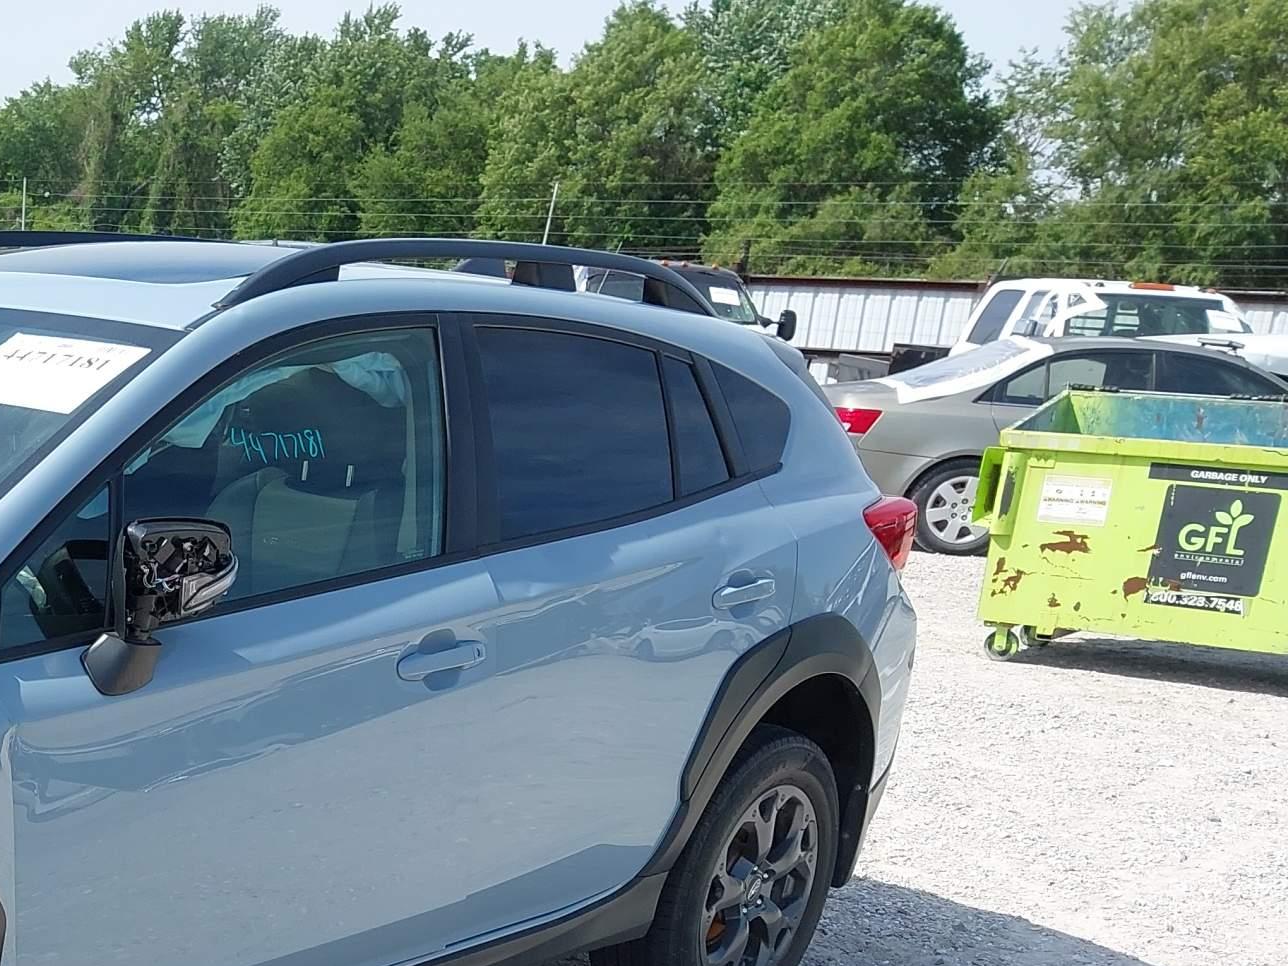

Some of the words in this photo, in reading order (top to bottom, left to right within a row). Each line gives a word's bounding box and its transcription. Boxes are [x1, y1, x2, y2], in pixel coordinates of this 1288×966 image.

[230, 427, 326, 464] 44717181
[1190, 470, 1238, 482] GARBAGE
[1238, 474, 1268, 484] ONLY
[1178, 512, 1254, 556] GFL
[1180, 571, 1228, 583] gflenv.com
